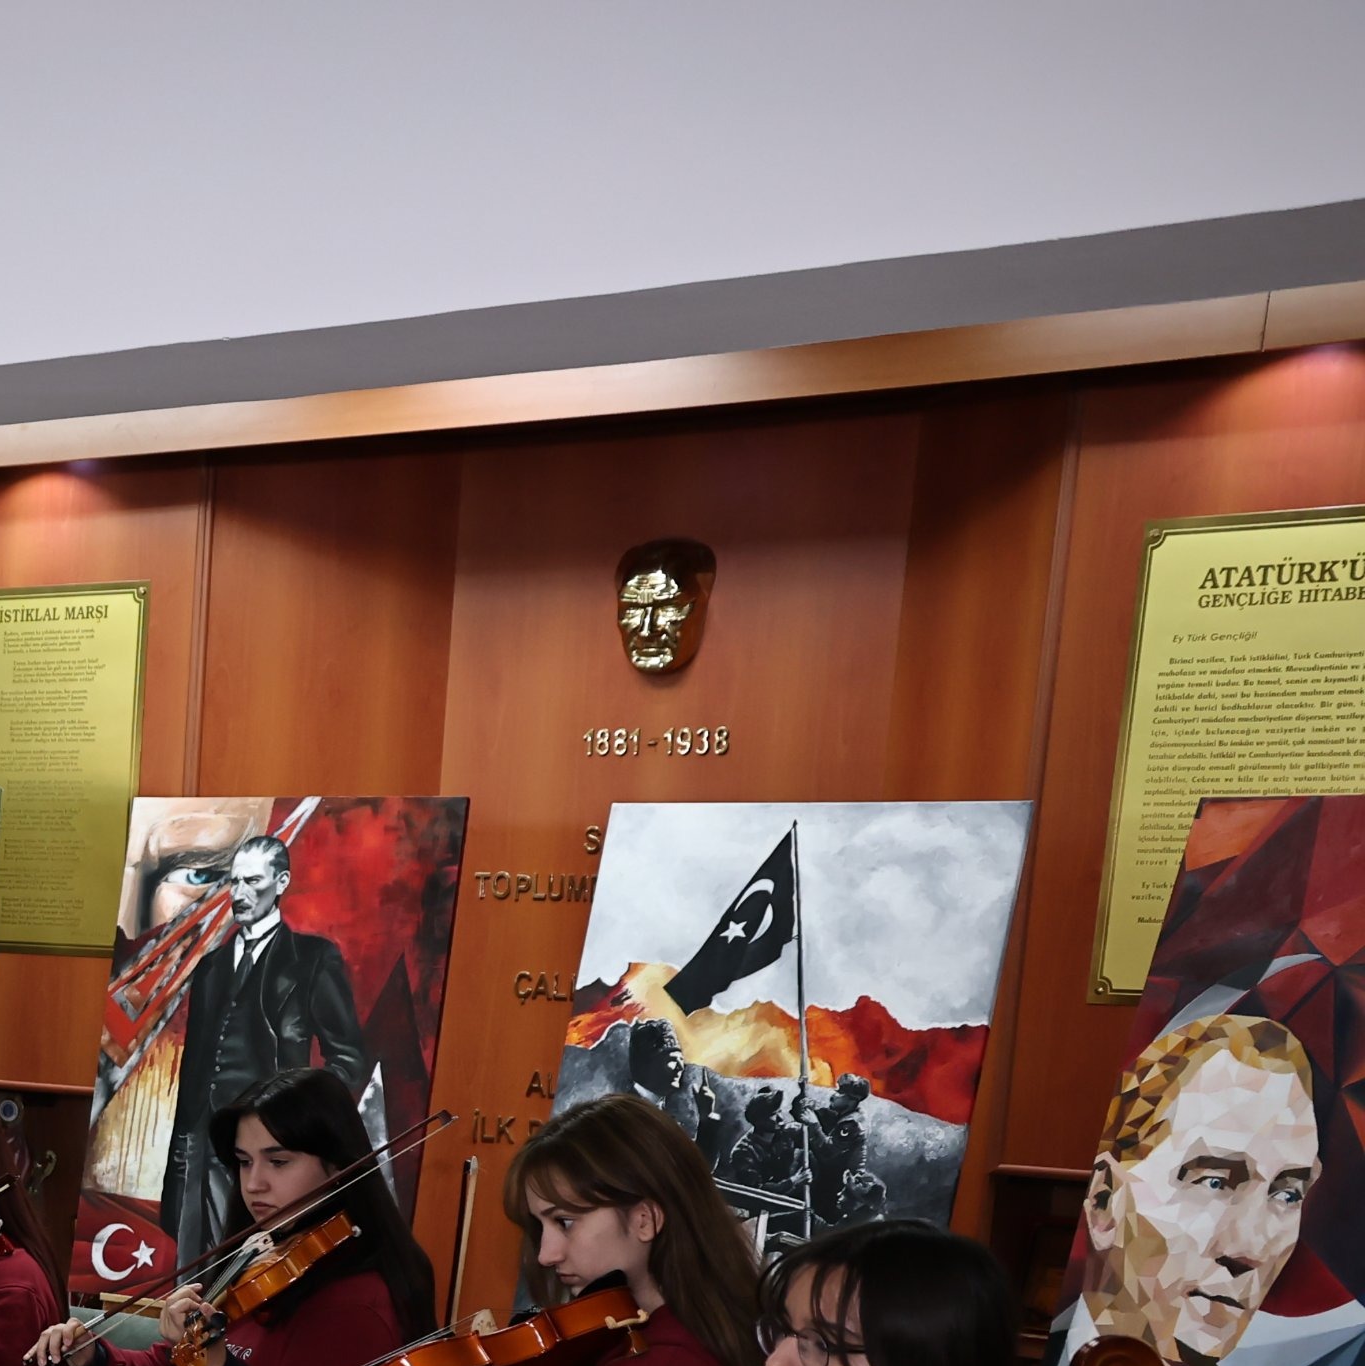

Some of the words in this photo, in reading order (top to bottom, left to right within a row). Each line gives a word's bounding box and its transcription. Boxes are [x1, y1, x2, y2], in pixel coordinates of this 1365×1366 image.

[1198, 586, 1293, 610] GENÇLİĞE
[0, 604, 60, 623] İSTİKLAL
[65, 605, 108, 623] MARŞI
[1172, 634, 1184, 644] Ey
[1187, 633, 1207, 643] Türk
[1210, 631, 1258, 642] Gençliği!
[472, 1108, 516, 1145] İLK
